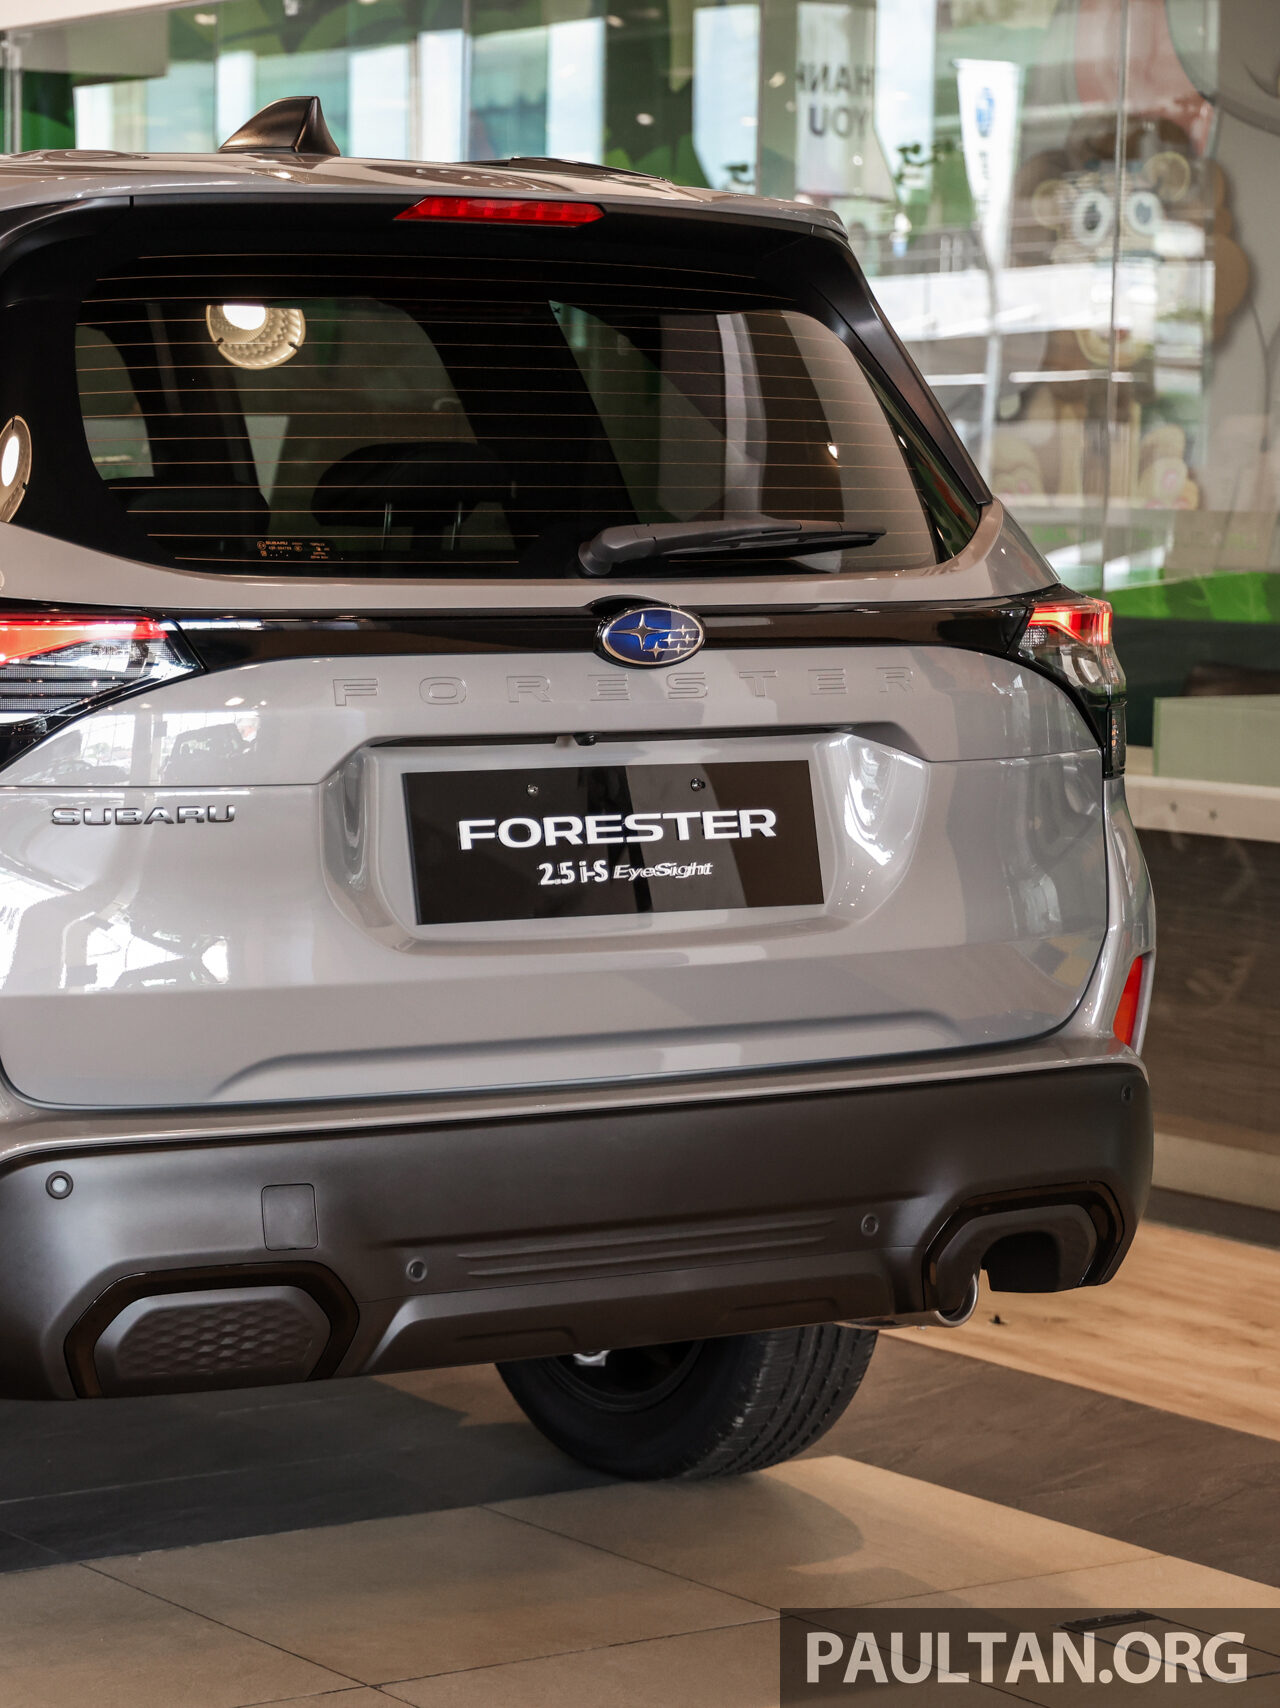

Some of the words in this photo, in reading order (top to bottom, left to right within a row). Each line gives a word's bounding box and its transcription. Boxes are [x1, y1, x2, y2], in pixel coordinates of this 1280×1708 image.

[332, 665, 914, 706] FORESTER
[51, 805, 236, 826] SUBARU
[458, 809, 777, 850] FORESTER
[538, 861, 575, 886] 2.5
[579, 860, 608, 884] i-S
[613, 862, 714, 881] EyeSight
